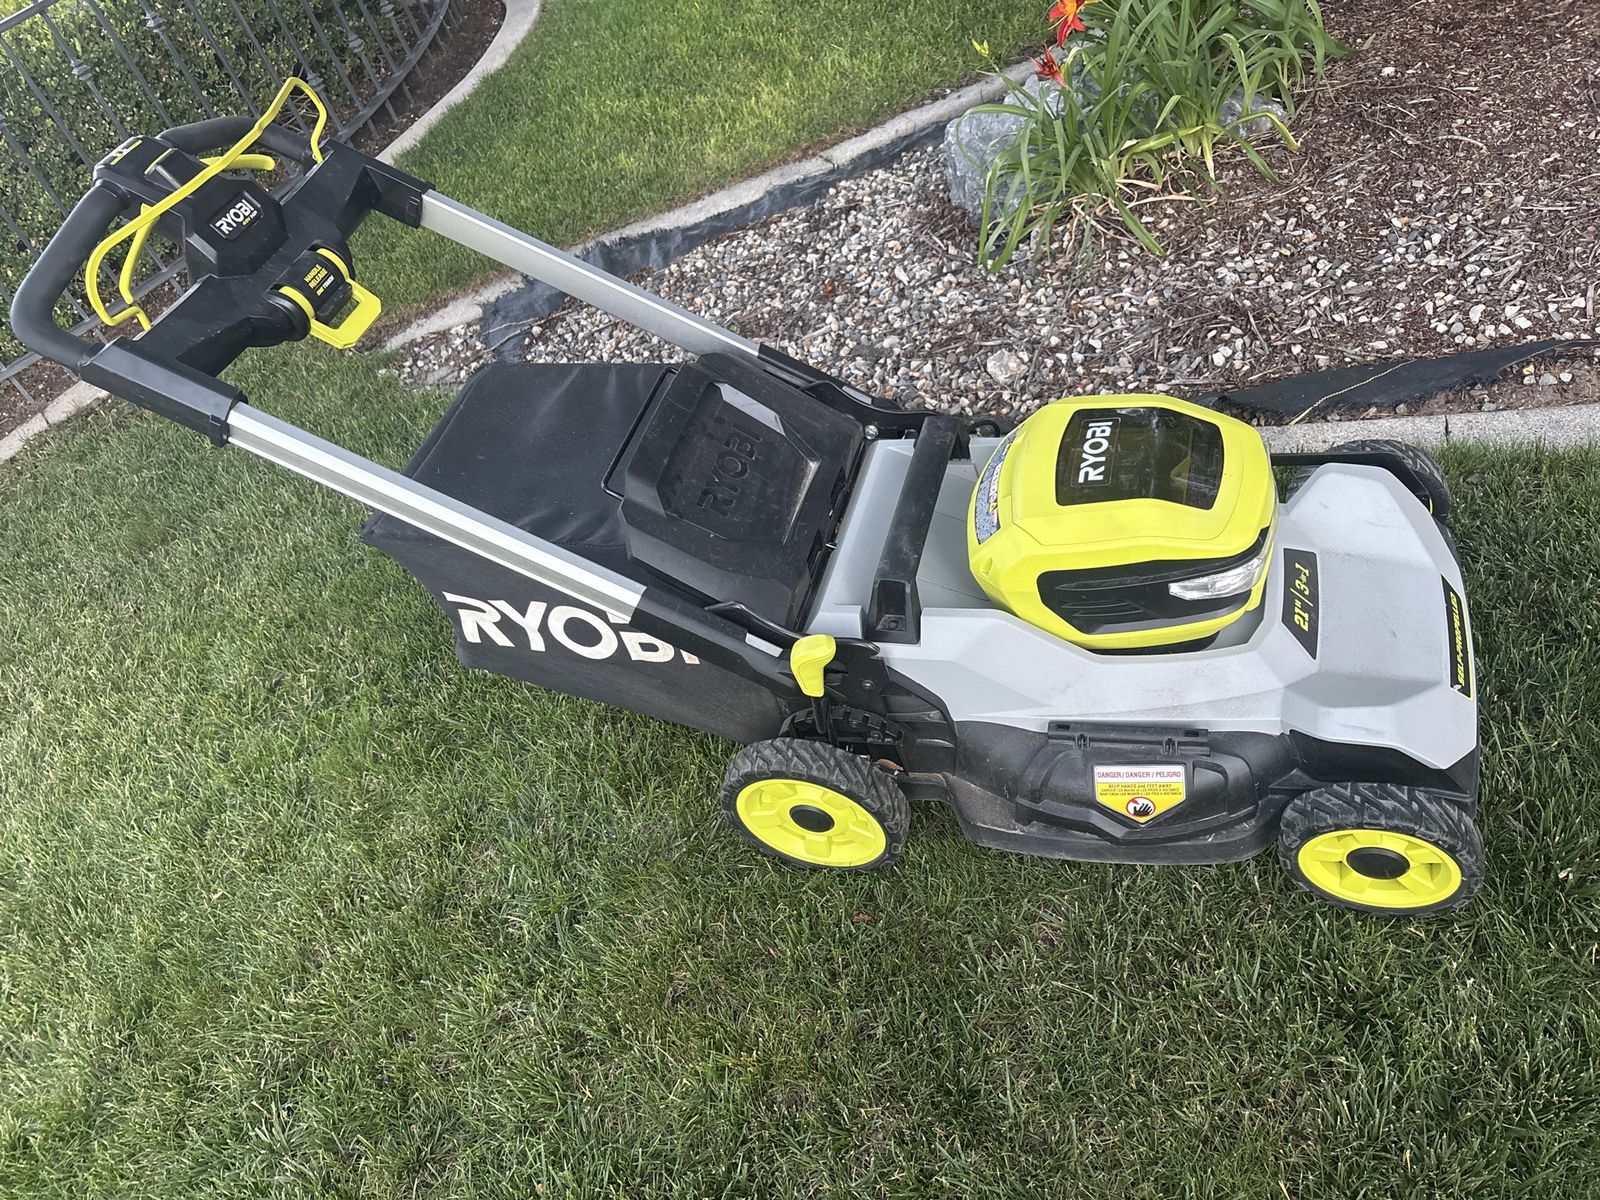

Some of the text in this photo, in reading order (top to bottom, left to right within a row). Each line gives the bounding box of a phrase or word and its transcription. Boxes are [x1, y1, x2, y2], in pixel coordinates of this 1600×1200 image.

[215, 199, 254, 234] RYOBI
[303, 263, 322, 283] HANDLE
[308, 267, 328, 289] RELEASE
[1079, 421, 1112, 483] RYOBI
[696, 423, 762, 518] RYOBI
[442, 591, 700, 665] RYOB
[1097, 771, 1121, 779] DANGER
[1125, 771, 1150, 779] DANGER
